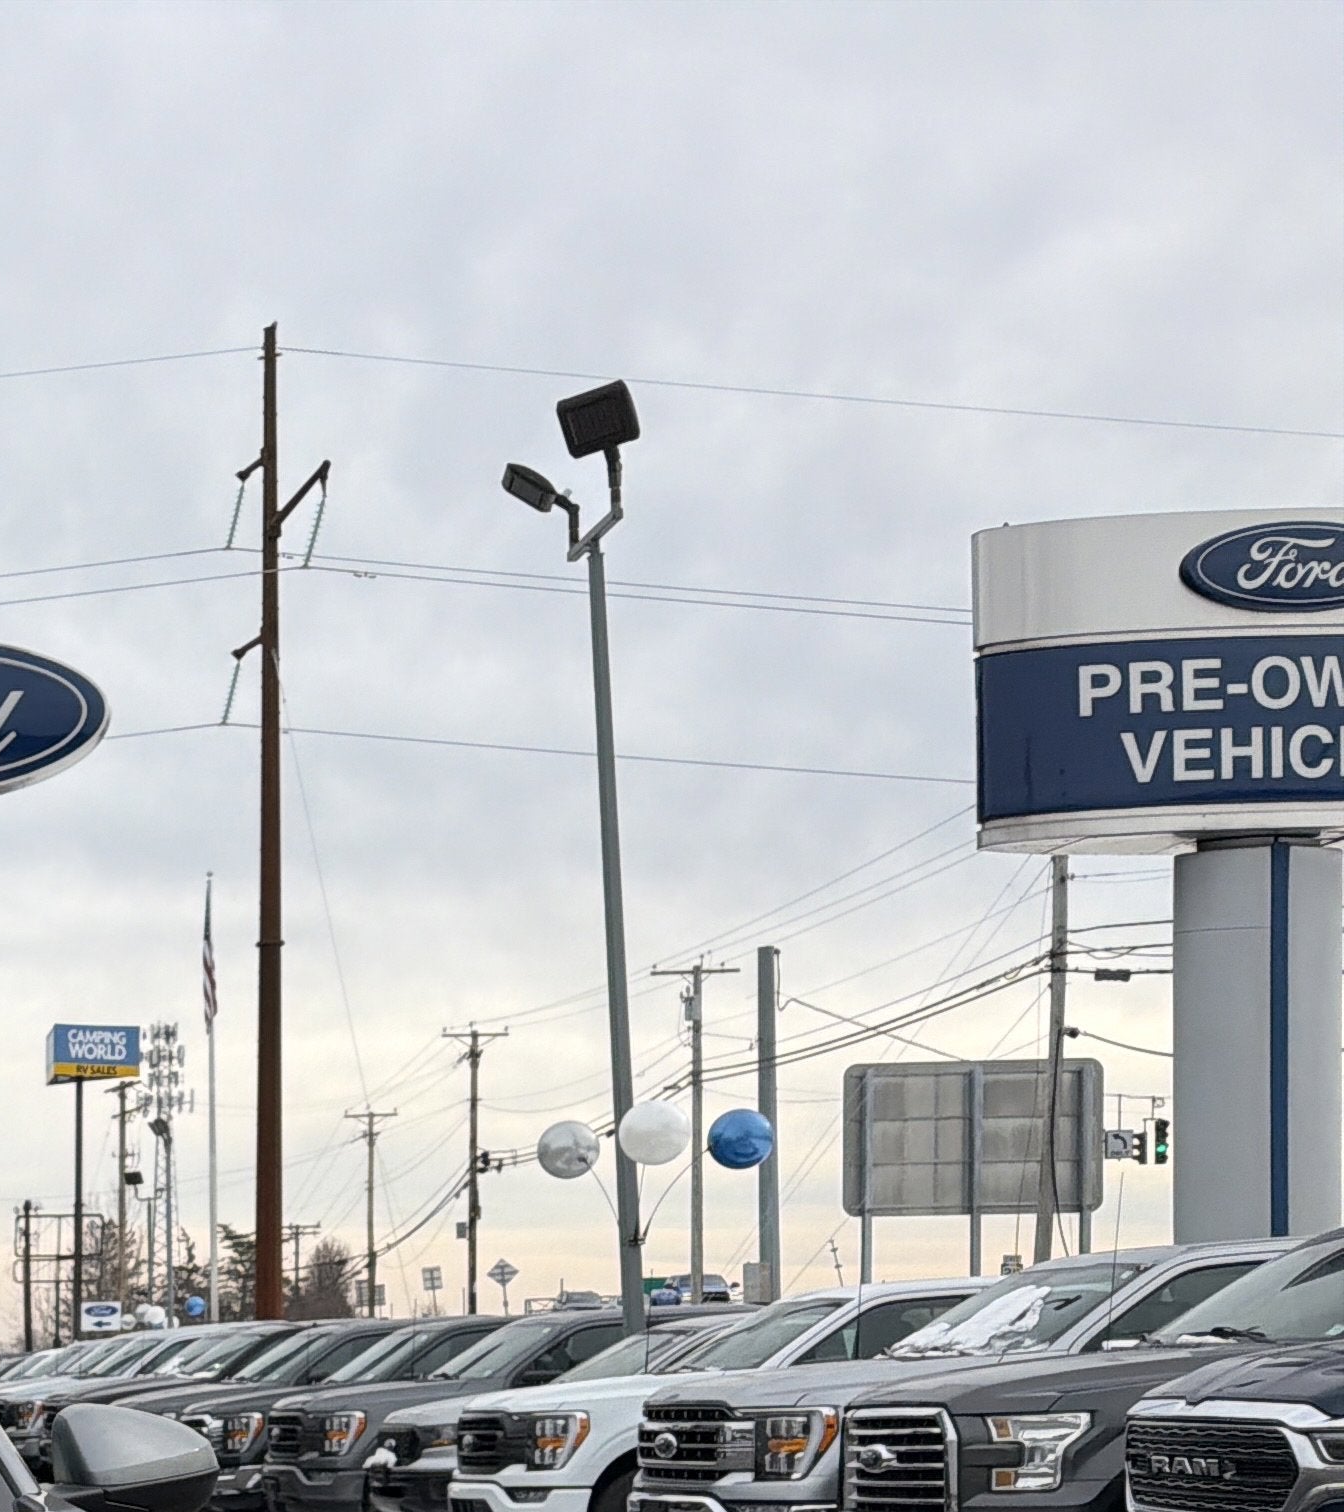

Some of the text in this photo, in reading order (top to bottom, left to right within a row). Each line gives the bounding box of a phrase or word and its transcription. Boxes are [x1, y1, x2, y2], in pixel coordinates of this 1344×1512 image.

[1120, 724, 1344, 783] VEHIC
[67, 1029, 127, 1045] CAMPING
[68, 1042, 128, 1060] WORLD
[76, 1064, 118, 1075] RV SALES
[1151, 1455, 1220, 1477] RAM
